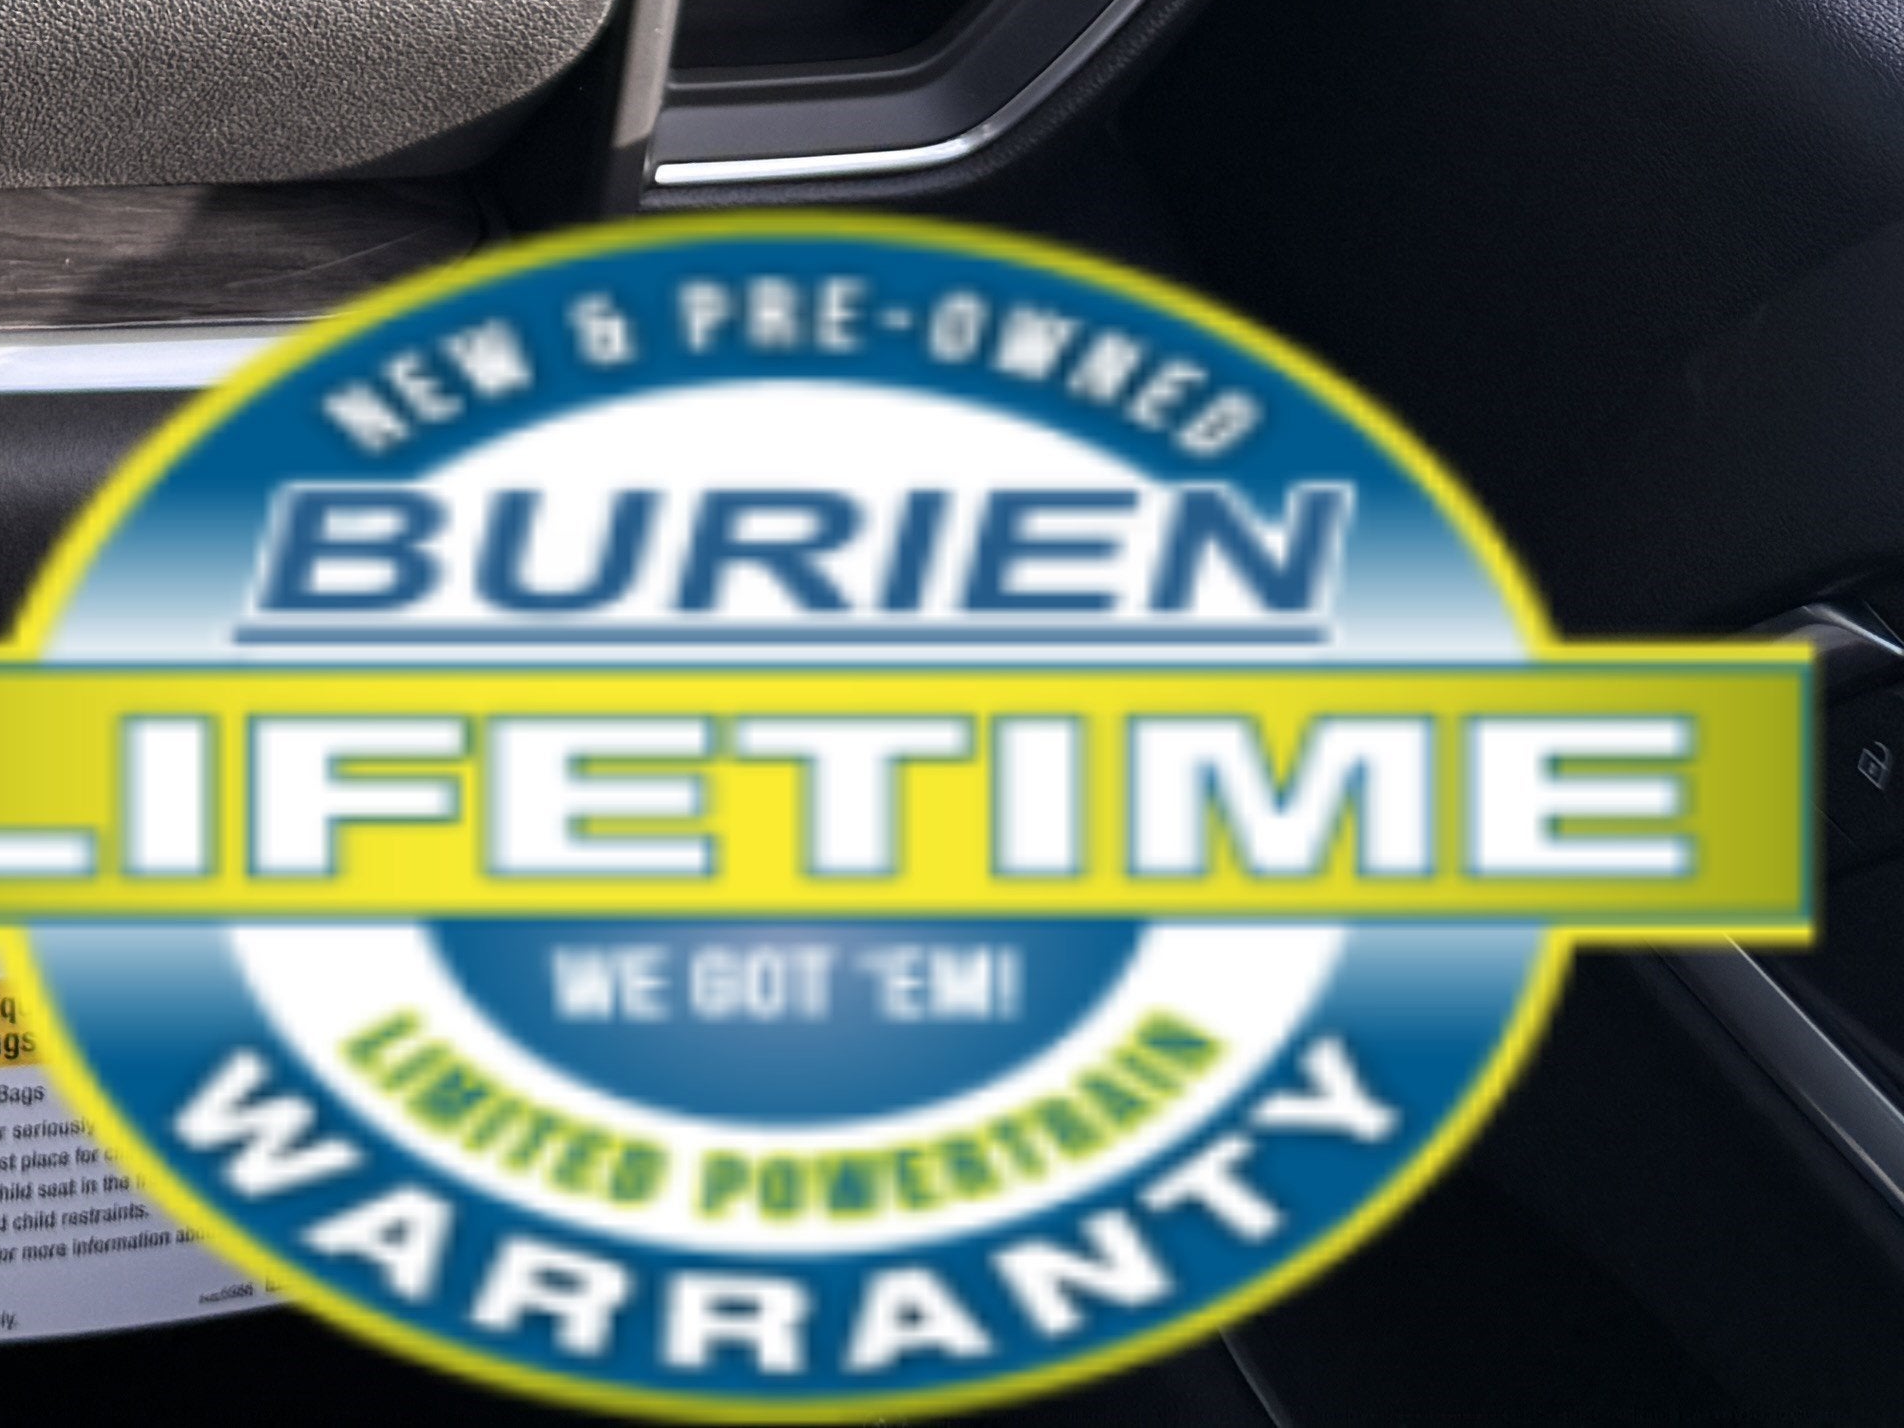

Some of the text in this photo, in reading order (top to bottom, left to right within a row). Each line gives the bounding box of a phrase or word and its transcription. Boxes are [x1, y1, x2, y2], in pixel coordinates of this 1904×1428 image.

[21, 1150, 70, 1172] place
[75, 1147, 99, 1165] for
[38, 1178, 77, 1198] seat
[81, 1176, 97, 1194] in
[103, 1174, 130, 1192] the
[13, 1210, 56, 1231] child
[61, 1202, 150, 1227] restraints.
[22, 1242, 66, 1261] more
[72, 1230, 171, 1256] information
